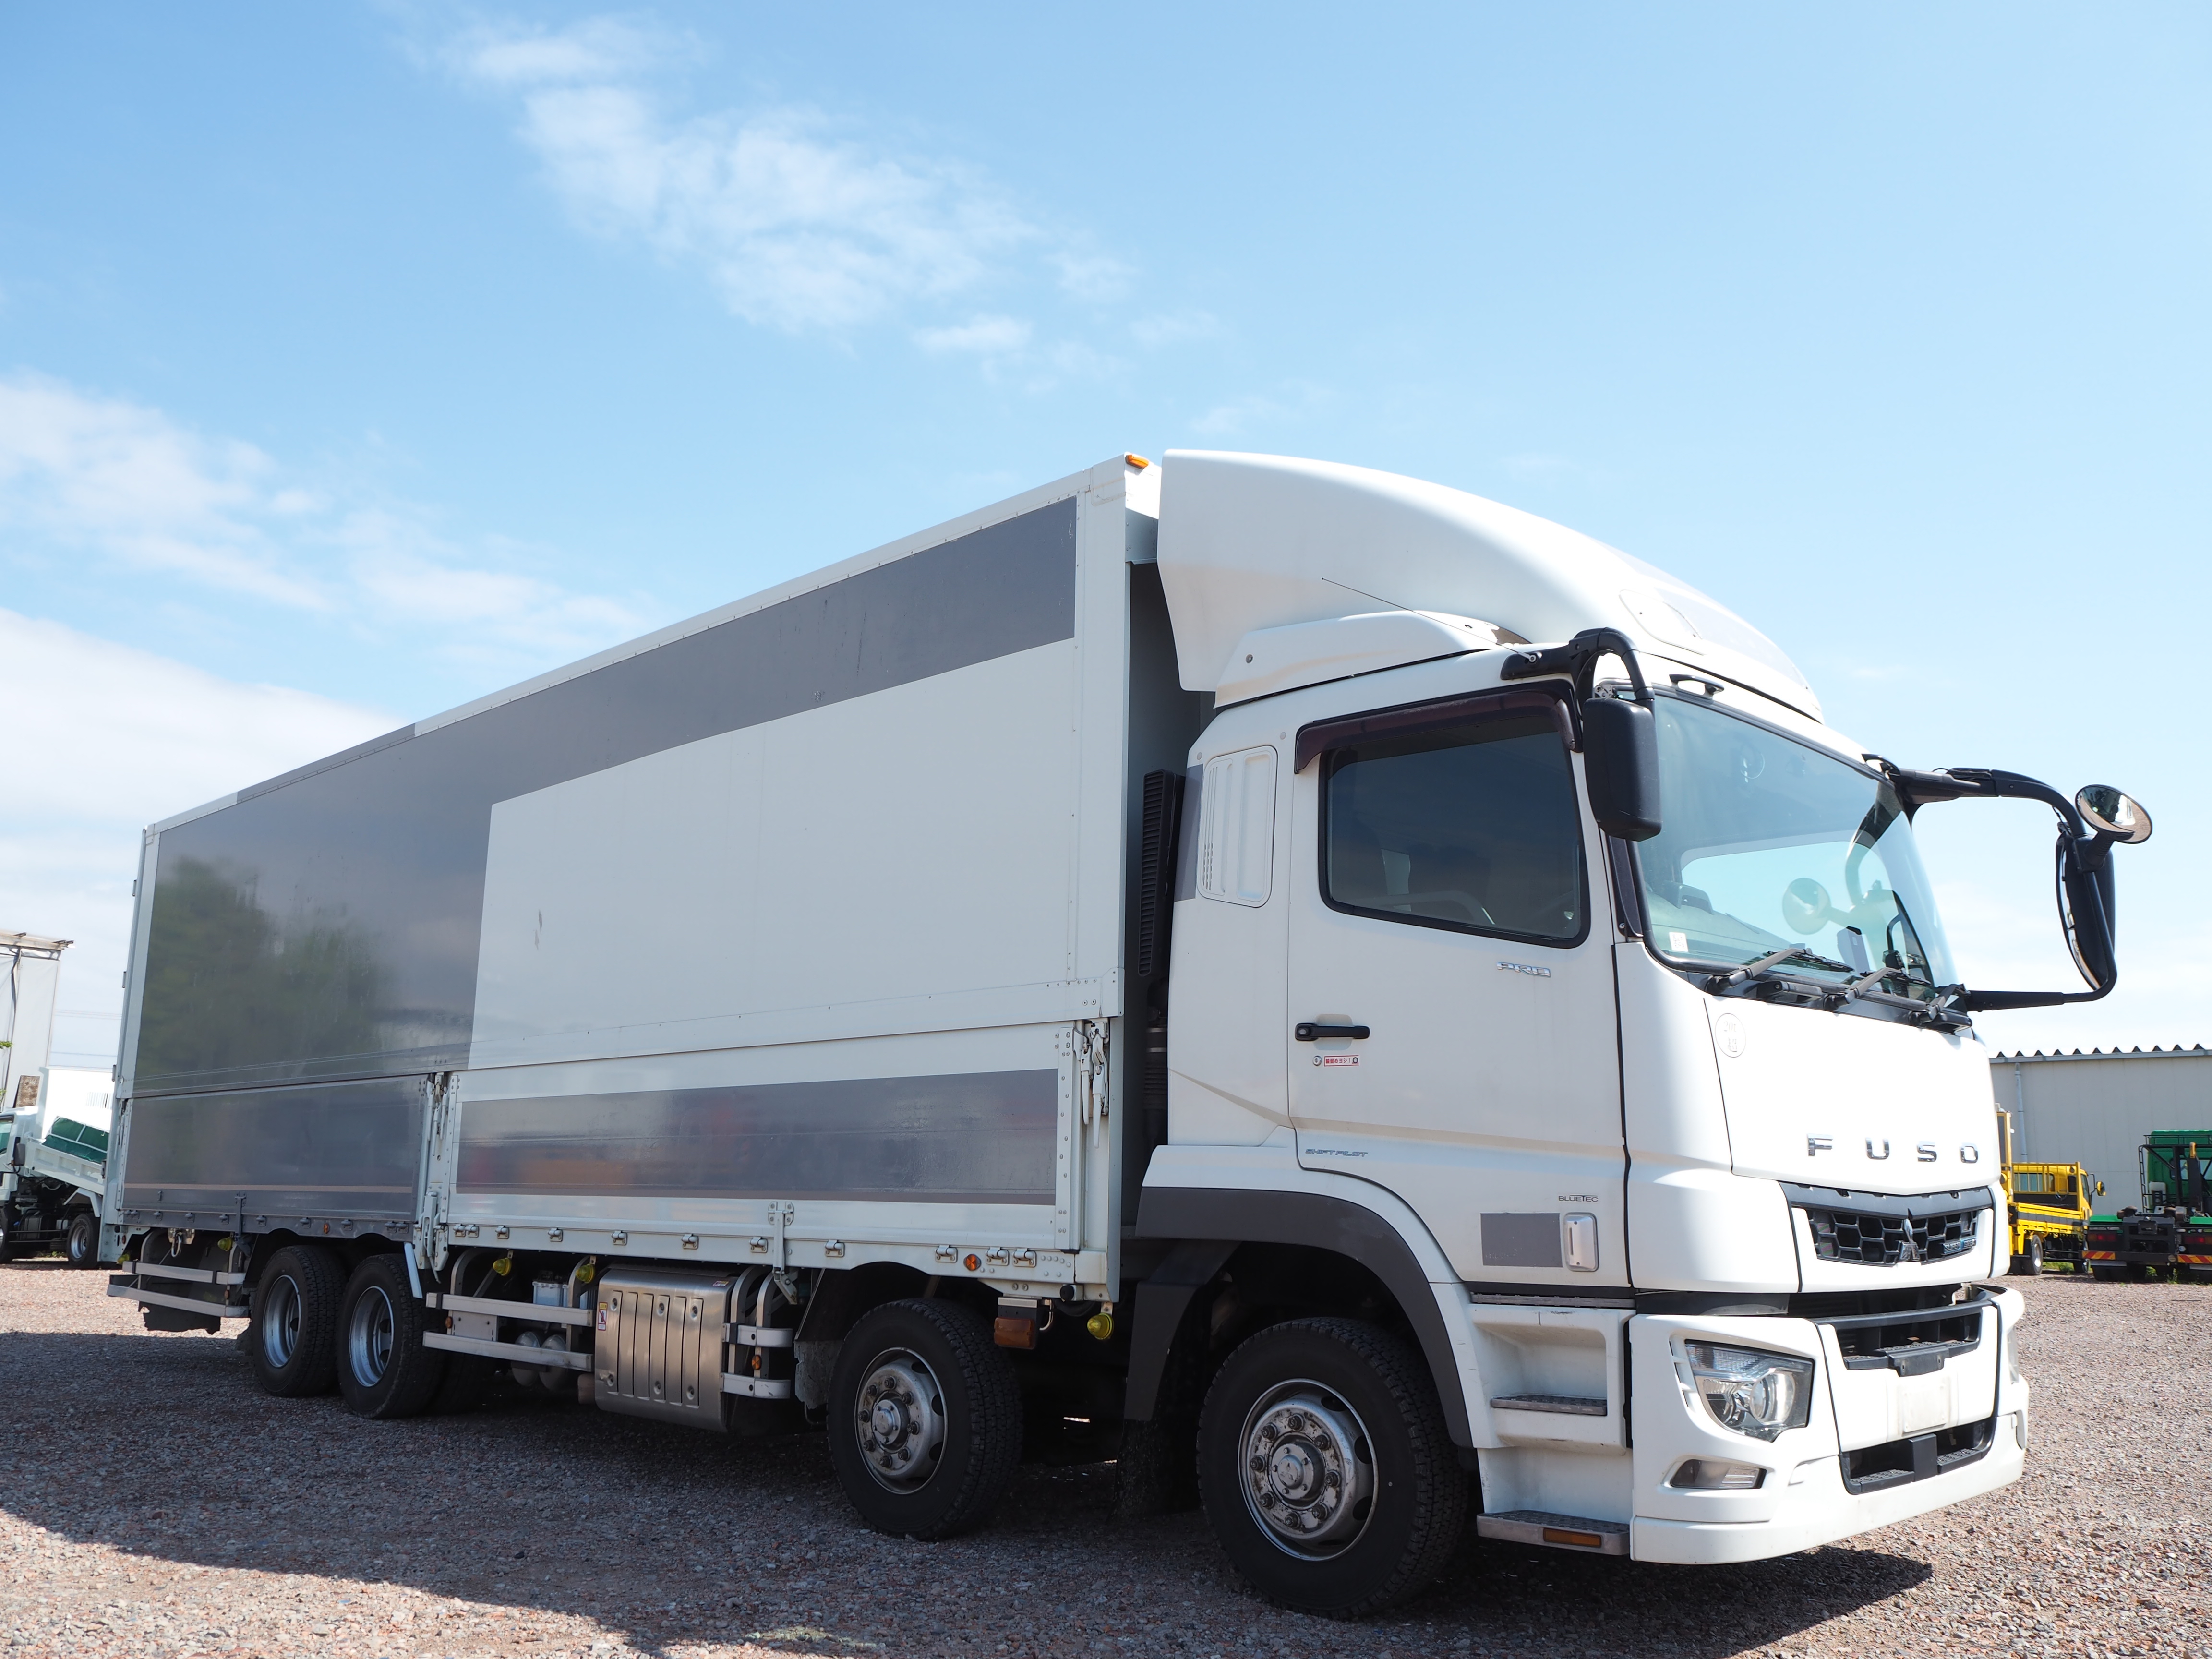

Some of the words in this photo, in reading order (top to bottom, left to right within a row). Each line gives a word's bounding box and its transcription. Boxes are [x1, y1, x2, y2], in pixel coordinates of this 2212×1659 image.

[1496, 961, 1551, 978] PRO
[1806, 1133, 1979, 1164] FUSO
[1558, 1194, 1599, 1202] BLUETEC
